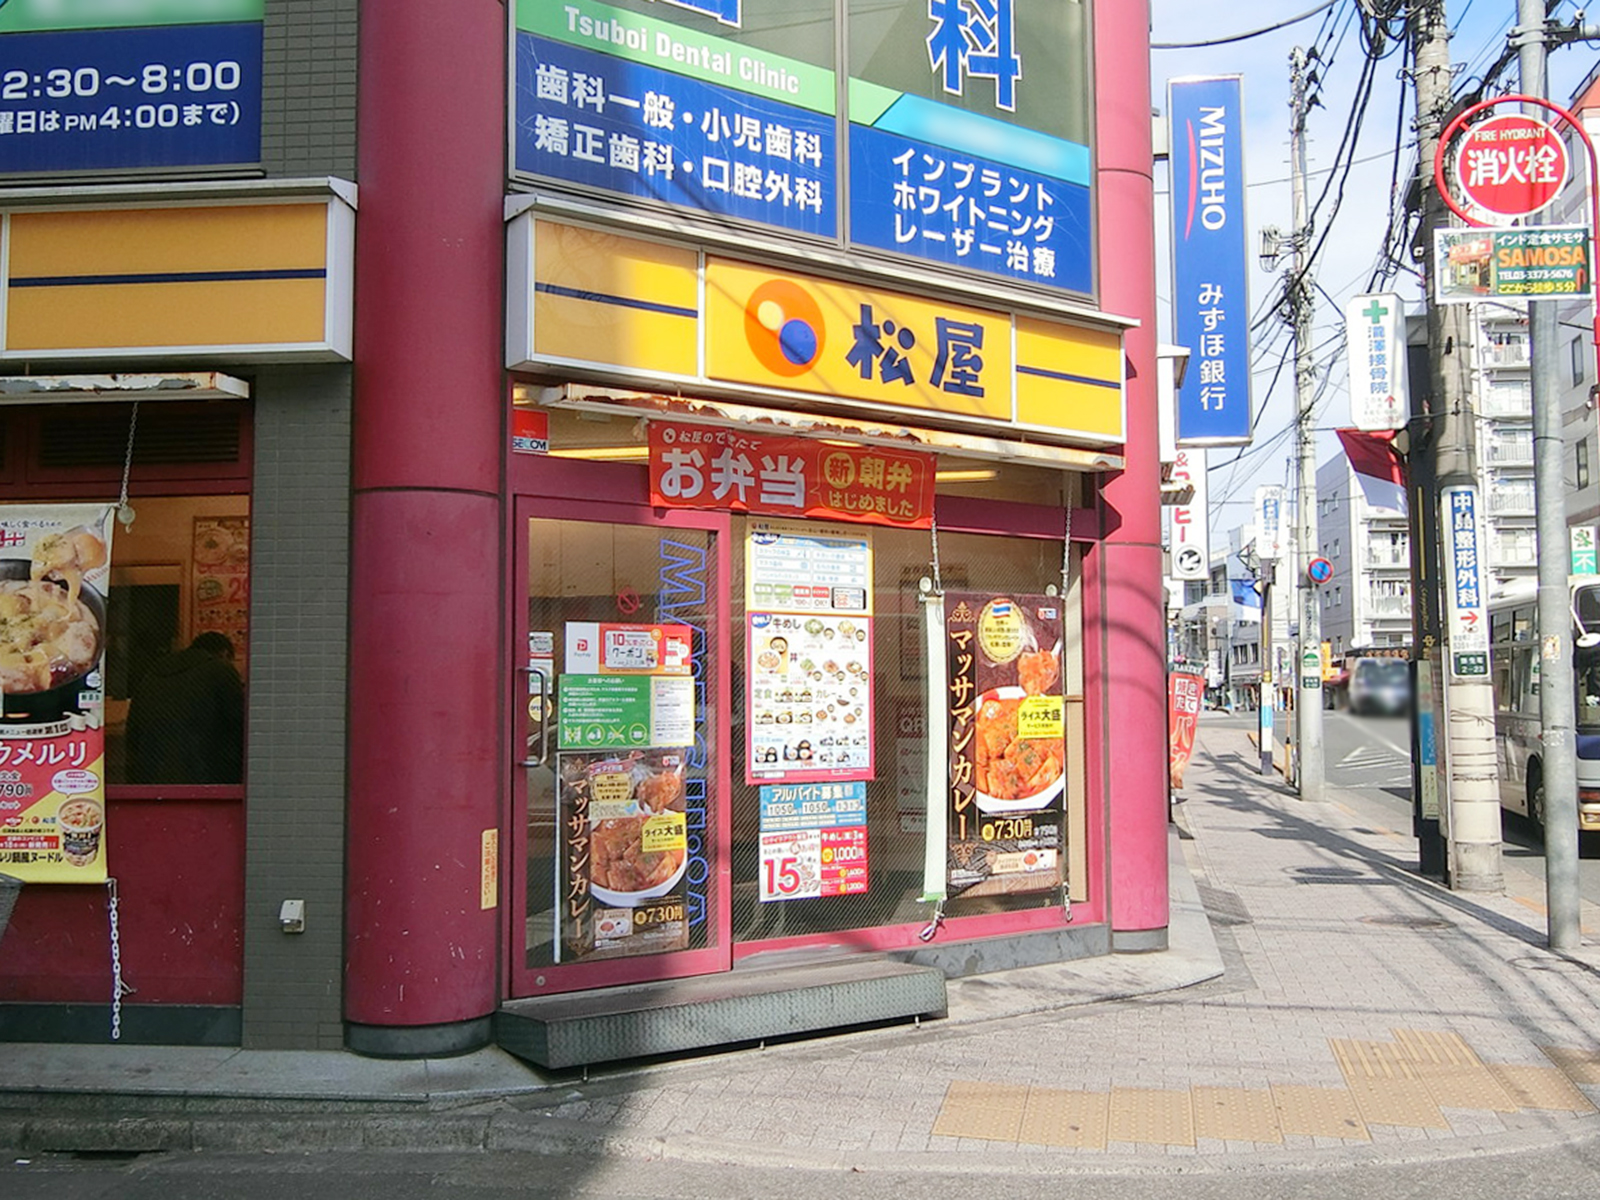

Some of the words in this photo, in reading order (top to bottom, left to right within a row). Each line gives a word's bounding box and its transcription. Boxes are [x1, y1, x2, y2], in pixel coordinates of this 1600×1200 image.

[565, 5, 649, 52] Tsuboi
[655, 34, 732, 76] Dental
[738, 56, 800, 95] Clinic
[535, 63, 823, 168] 歯科一般・小児歯科
[1474, 128, 1497, 142] FIRE
[1500, 126, 1546, 141] HYDRANT
[535, 114, 824, 215] 矯正歯科・口腔外科
[892, 148, 1054, 211] インプラント
[1199, 105, 1227, 231] MIZUHO
[1467, 145, 1559, 188] 消火栓
[892, 181, 1056, 241] ホワイトニング
[893, 221, 1057, 280] レーザー治療
[1498, 245, 1586, 268] SAMOSA
[845, 303, 985, 399] 松屋
[1198, 283, 1227, 411] みずほ銀行
[513, 437, 547, 451] SECOM
[828, 458, 850, 483] 新
[659, 447, 806, 509] お弁当
[828, 489, 914, 517] はじめました
[858, 456, 913, 494] 朝弁
[950, 629, 976, 841] マッサマンカレー
[567, 778, 590, 938] マッサマンカレー
[764, 857, 801, 895] 15
